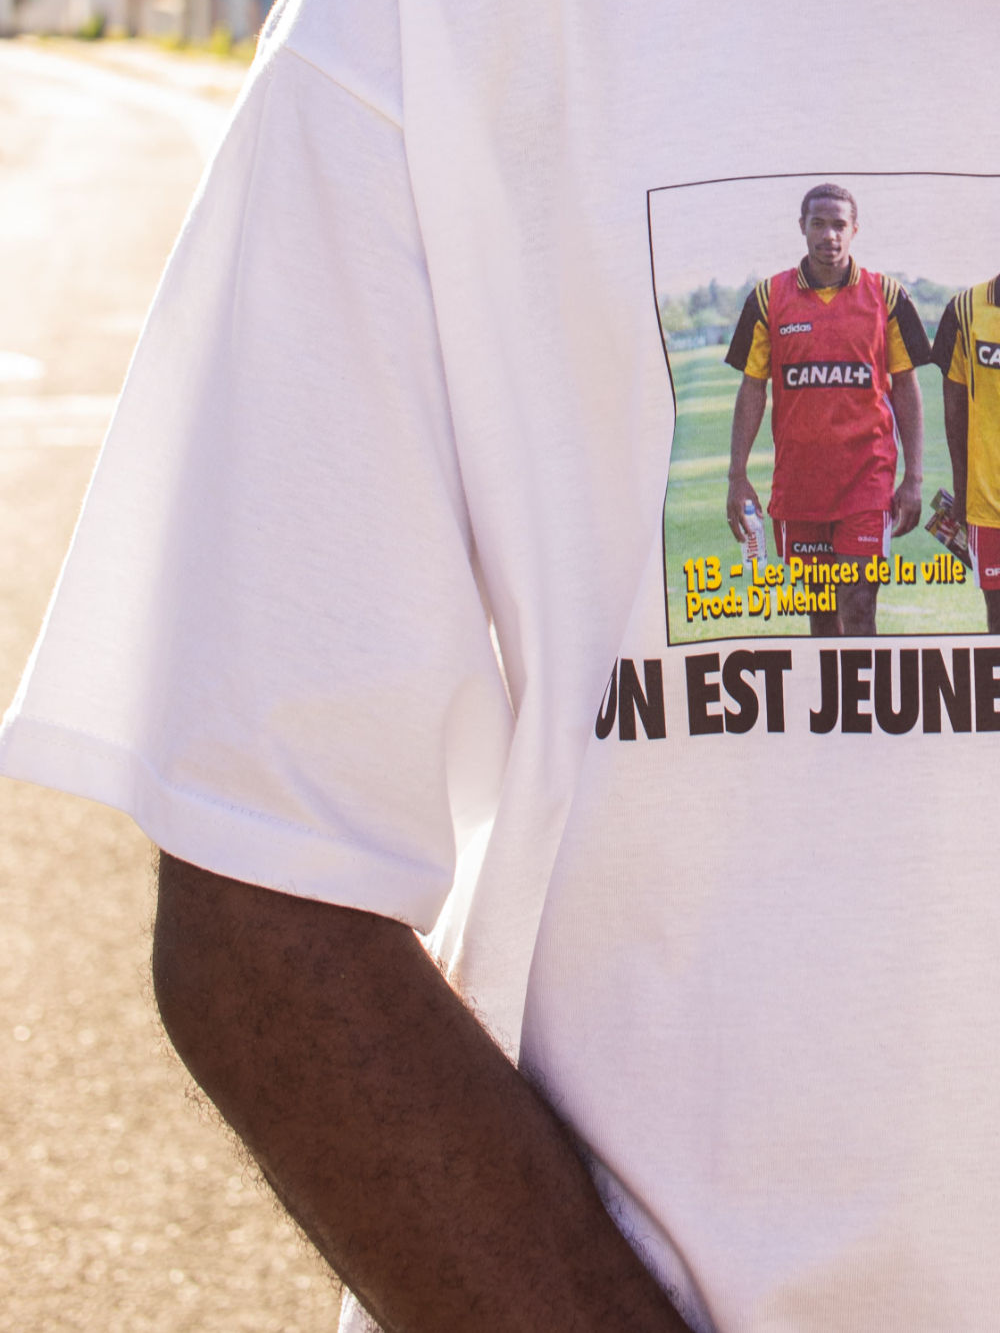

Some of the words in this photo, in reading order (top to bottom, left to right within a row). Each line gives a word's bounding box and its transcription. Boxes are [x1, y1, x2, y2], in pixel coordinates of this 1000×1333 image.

[779, 321, 812, 336] adidas
[786, 365, 871, 387] CANAL+
[683, 555, 723, 592] 113
[751, 557, 784, 587] Les
[789, 556, 860, 587] Princes
[864, 554, 891, 584] de
[895, 554, 916, 583] la
[920, 553, 967, 584] ville
[685, 586, 744, 622] Prod:
[747, 584, 771, 621] Dj
[776, 584, 838, 615] Mehdi
[684, 648, 794, 736] EST
